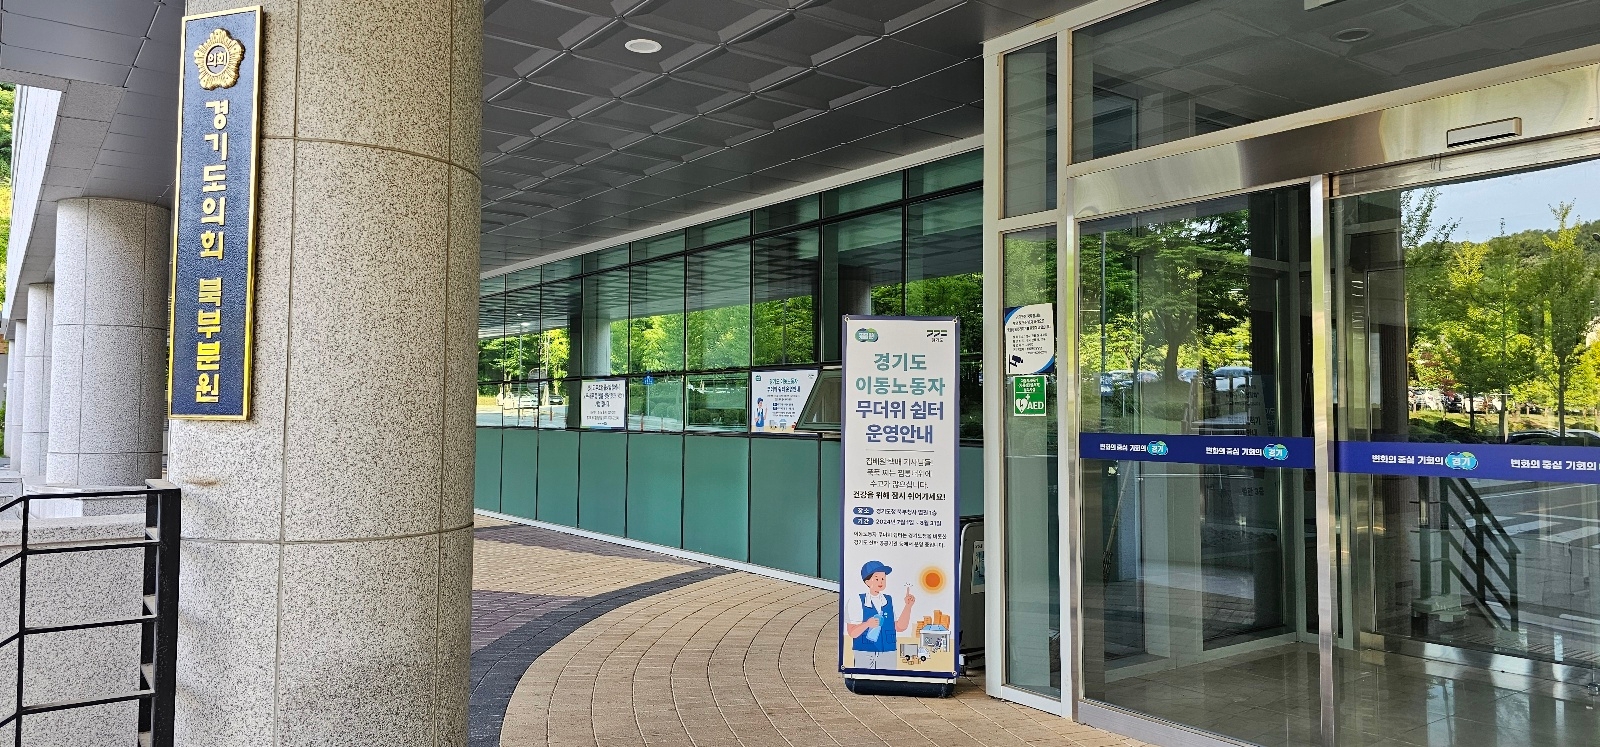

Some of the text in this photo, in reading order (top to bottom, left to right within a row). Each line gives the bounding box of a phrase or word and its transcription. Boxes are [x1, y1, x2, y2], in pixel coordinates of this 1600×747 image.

[207, 53, 228, 68] 의회
[196, 99, 229, 403] 경기도의회 북부분원
[874, 353, 927, 371] 경기도
[856, 376, 945, 396] 이동노동자
[856, 400, 944, 420] 무더위 쉼터
[1027, 401, 1044, 410] AED
[866, 424, 933, 444] 운영안내
[1099, 443, 1165, 454] 변화의 중심 기회의 경기
[1205, 446, 1284, 458] 변화의 중심 기회의 경기
[1371, 454, 1472, 467] 변화의 중심 기회의 경기
[1510, 458, 1597, 471] 변화의 중심 기회의
[869, 480, 891, 488] 수고가
[853, 490, 946, 501] 건강을 위해 잠시 쉬어가세요!
